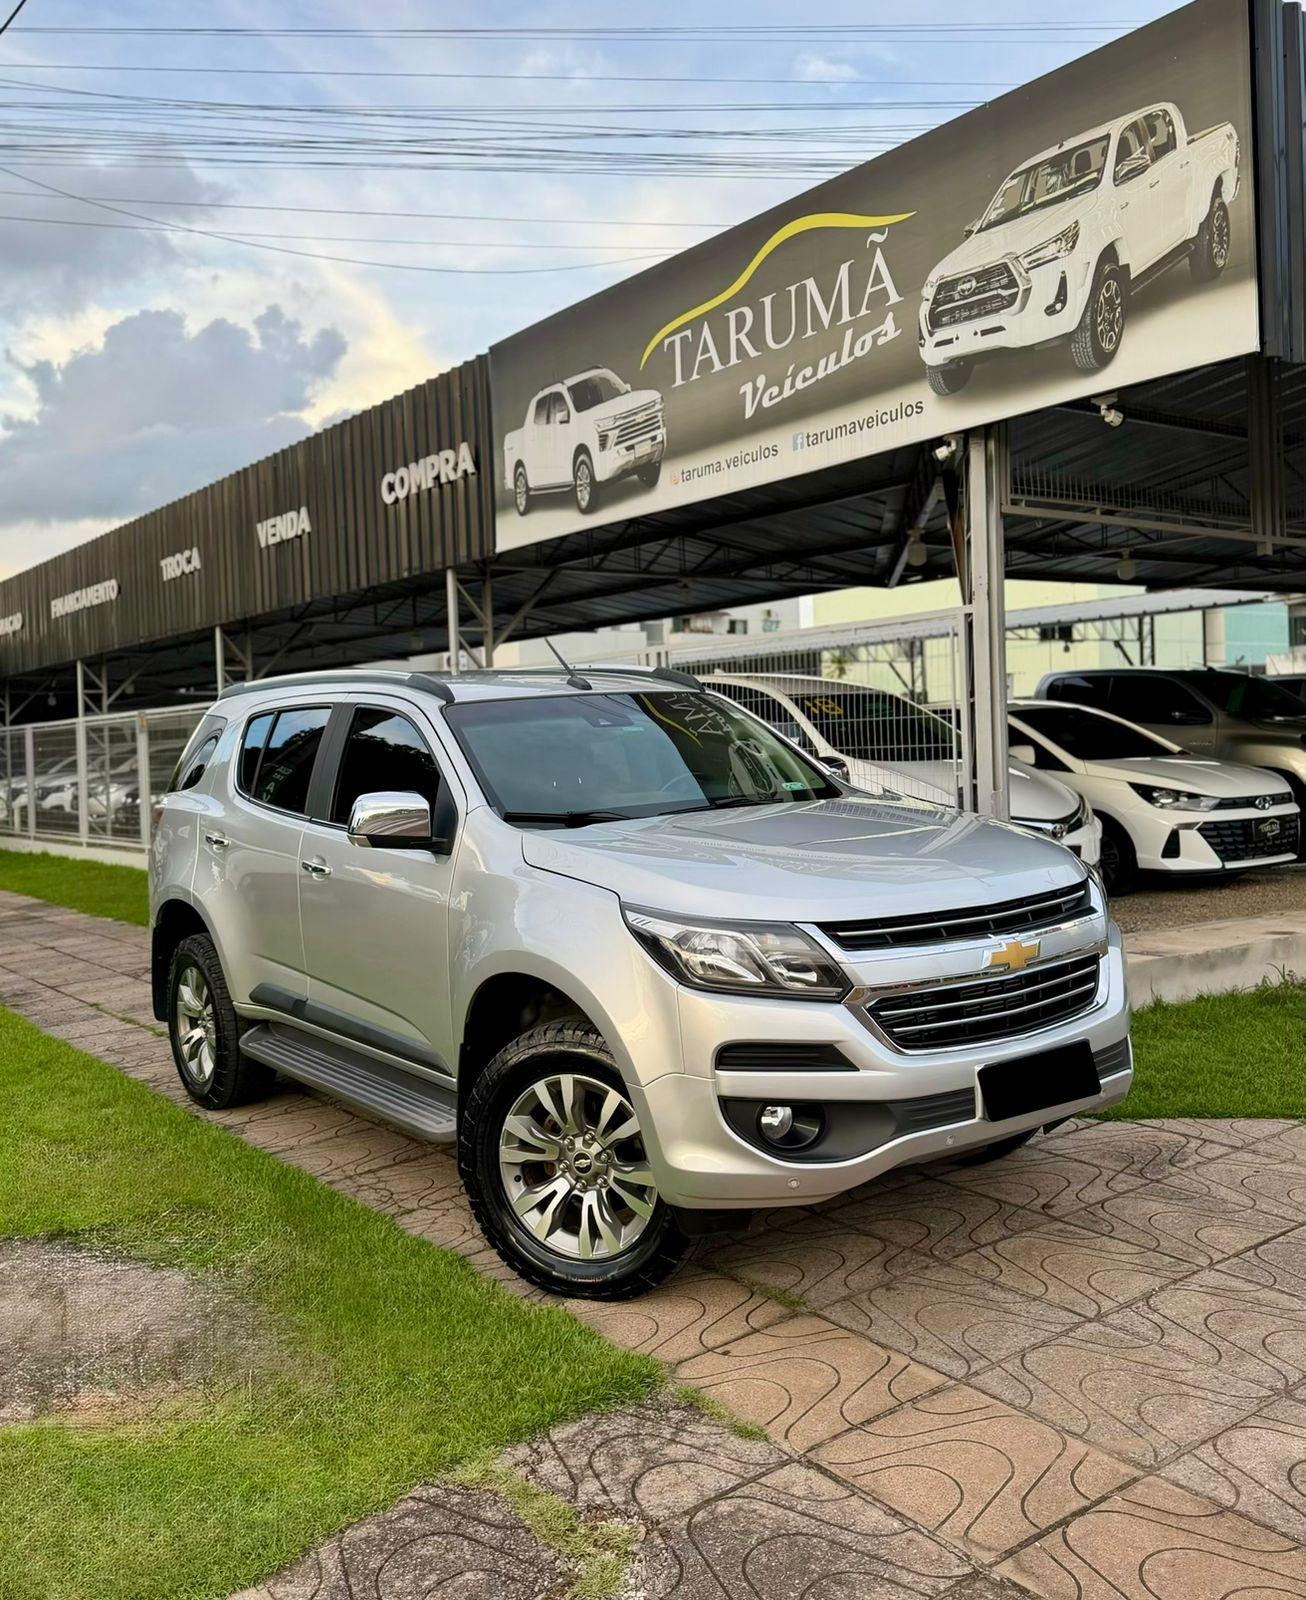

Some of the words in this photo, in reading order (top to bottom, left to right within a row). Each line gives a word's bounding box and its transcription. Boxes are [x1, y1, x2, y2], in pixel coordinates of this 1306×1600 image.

[664, 227, 904, 389] TARUMÃ
[739, 312, 902, 420] Veículos
[805, 400, 924, 447] tarumaveiculos
[380, 442, 476, 506] COMPRA
[681, 444, 779, 483] taruma.veiculos
[256, 506, 312, 548] VENDA
[160, 547, 201, 582] TROCA
